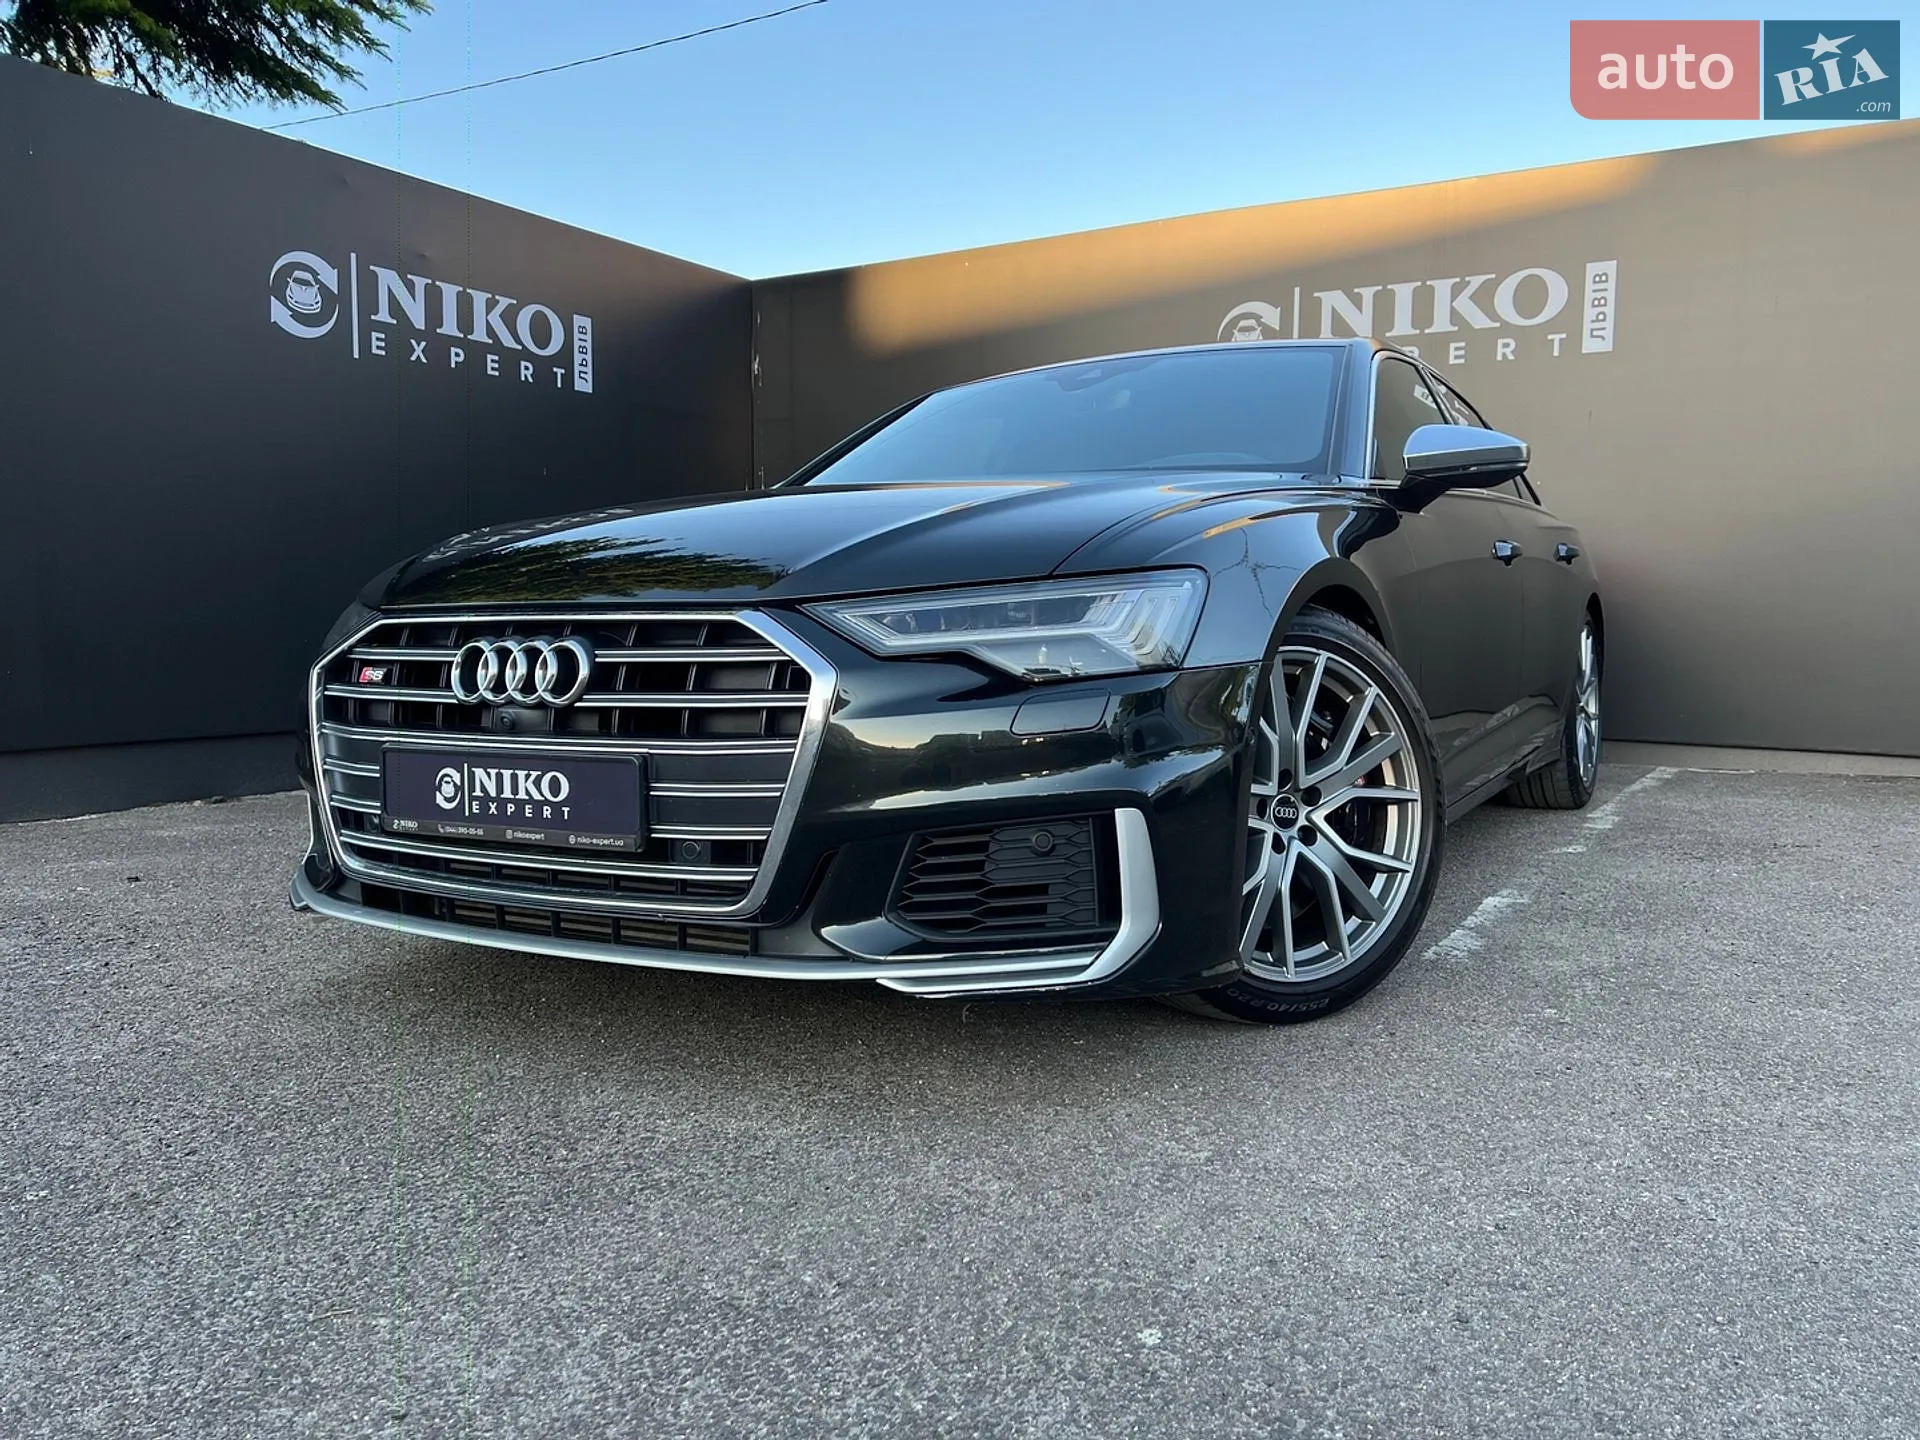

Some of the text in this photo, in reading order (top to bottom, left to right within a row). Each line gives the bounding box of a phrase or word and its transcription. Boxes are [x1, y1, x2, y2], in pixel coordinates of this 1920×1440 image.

[370, 265, 565, 357] NIKO
[1313, 267, 1569, 338] NIKO
[1589, 271, 1609, 341] ЛЬВІВ
[371, 331, 566, 388] EXPERT
[577, 325, 590, 384] ЛЬВІВ
[472, 767, 570, 802] NIKO
[472, 801, 571, 820] EXPERT
[577, 836, 624, 847] niko-expert.ua
